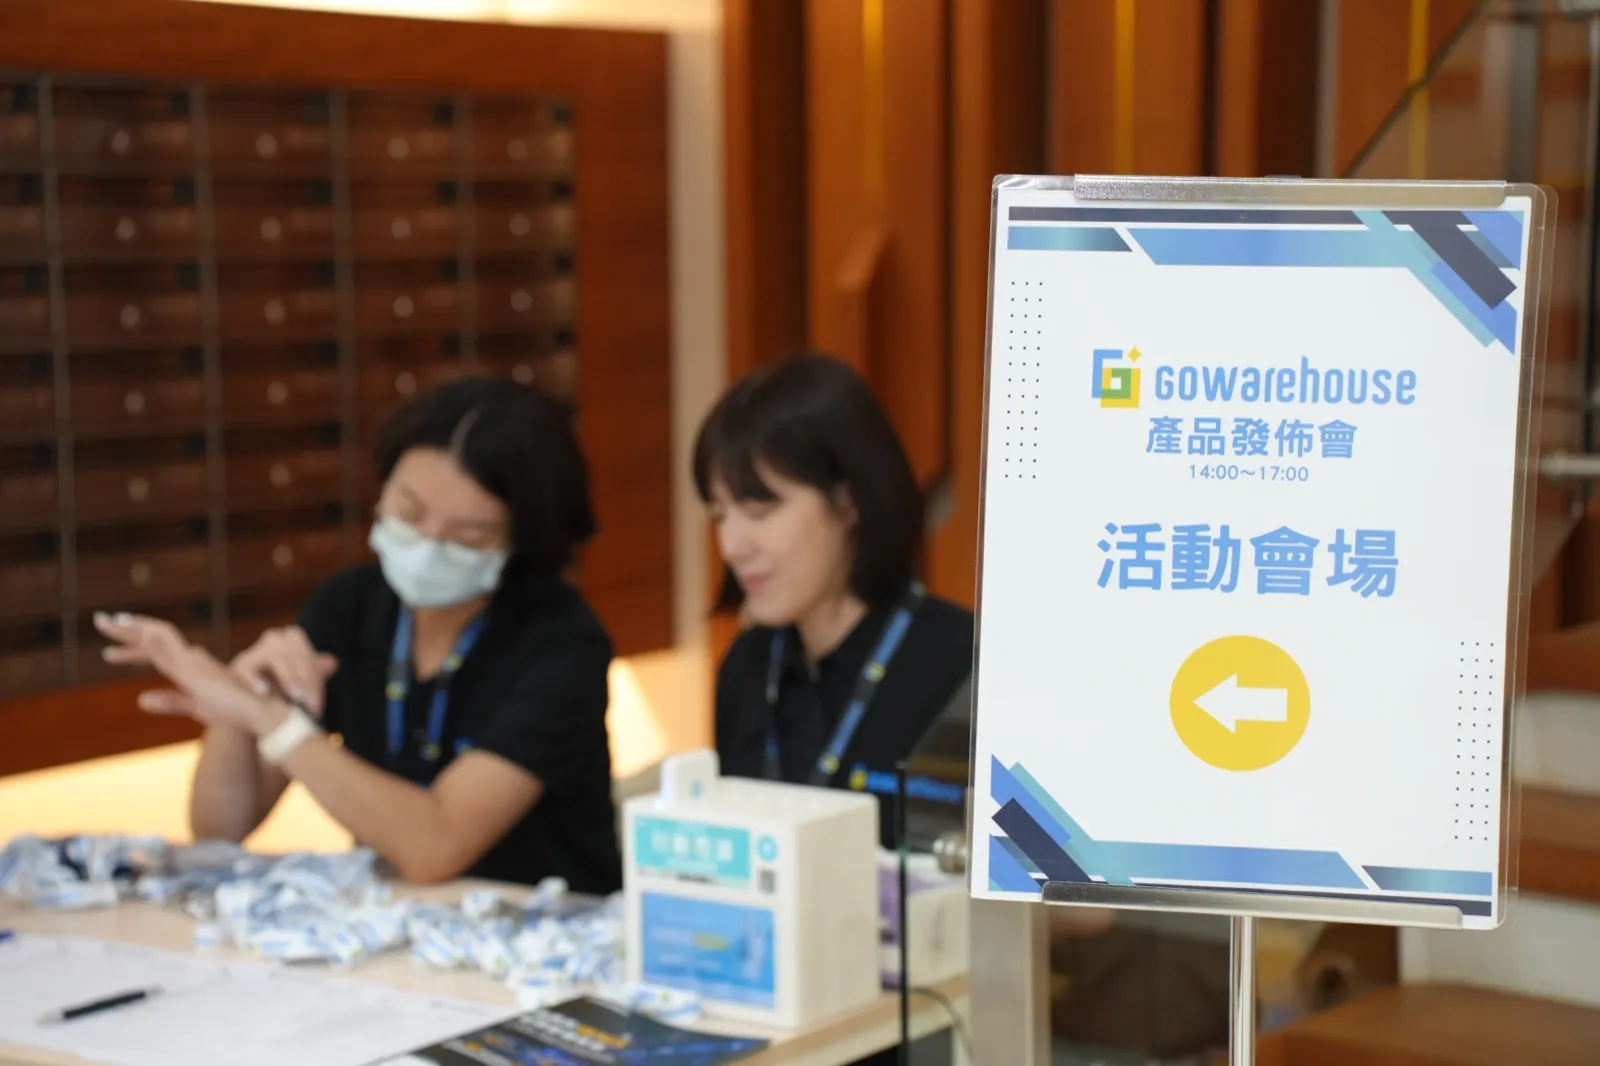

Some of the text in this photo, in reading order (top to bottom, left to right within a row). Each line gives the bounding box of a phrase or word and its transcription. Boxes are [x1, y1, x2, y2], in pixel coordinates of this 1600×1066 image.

[1146, 416, 1359, 459] 產品發佈會
[1097, 521, 1400, 599] 活動會場
